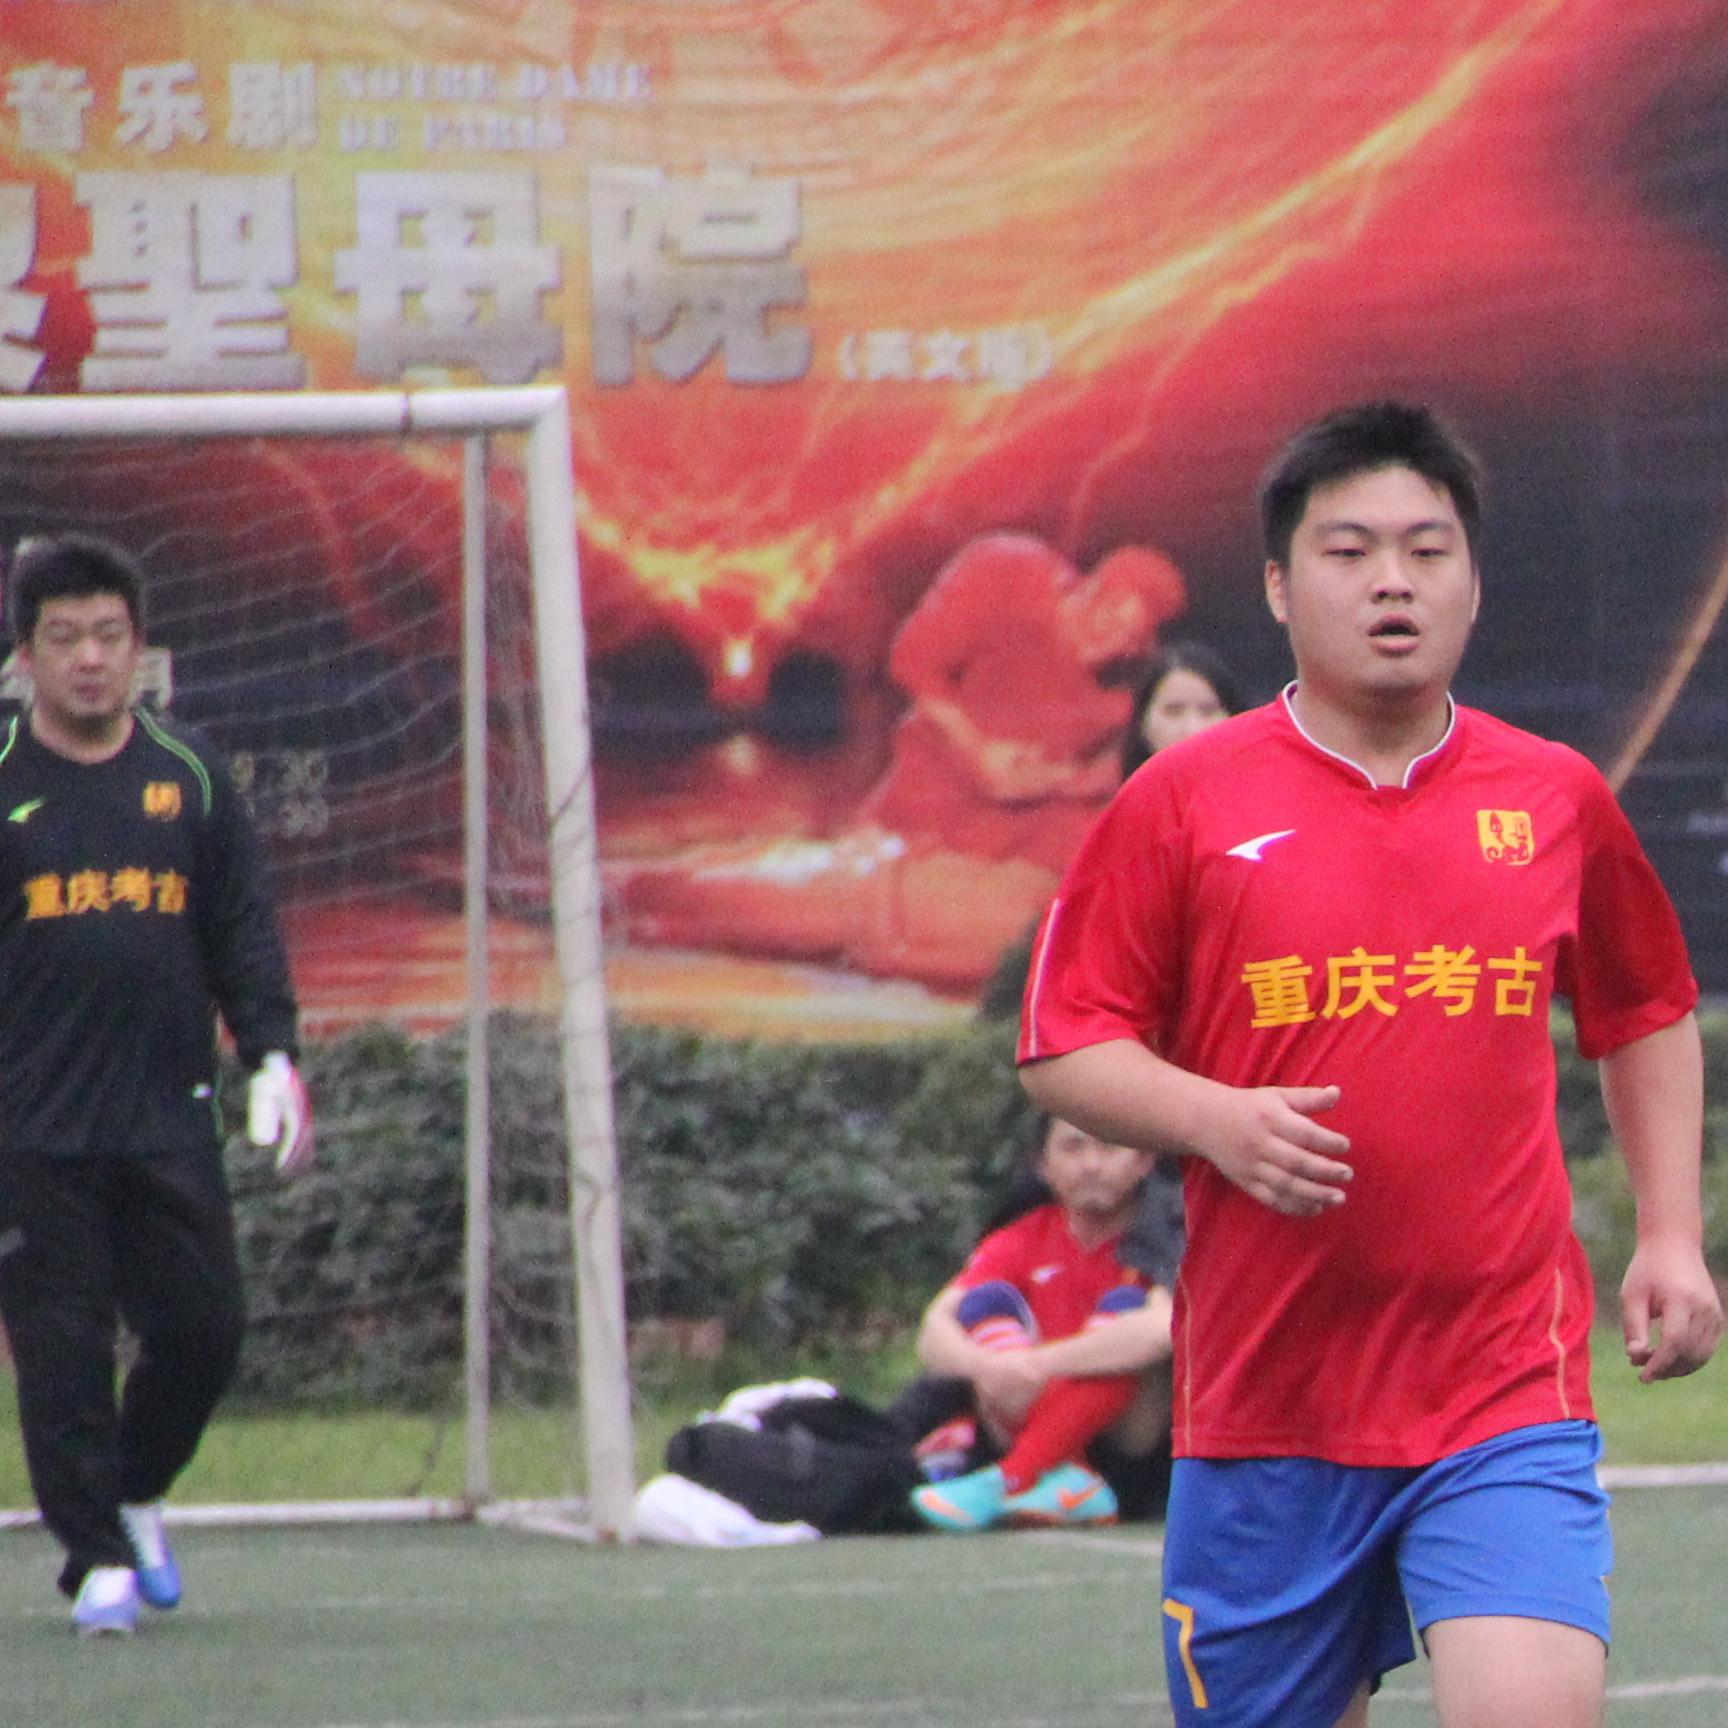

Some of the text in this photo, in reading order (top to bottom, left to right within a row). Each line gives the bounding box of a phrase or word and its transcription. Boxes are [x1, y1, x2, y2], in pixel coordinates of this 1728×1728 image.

[6, 60, 317, 153] 音乐剧
[1241, 944, 1544, 1029] 重庆考古
[1162, 1598, 1209, 1709] 7
